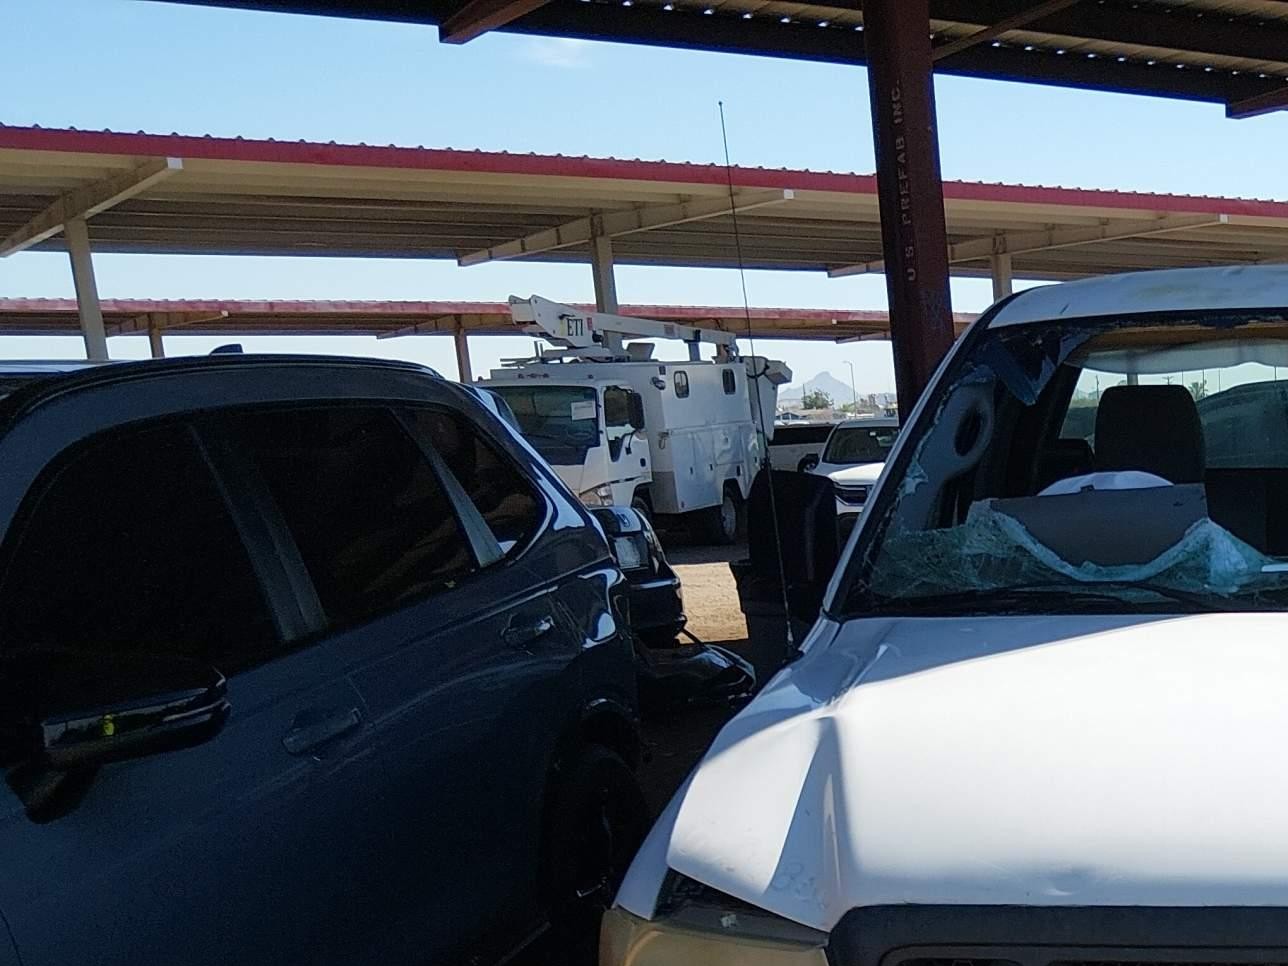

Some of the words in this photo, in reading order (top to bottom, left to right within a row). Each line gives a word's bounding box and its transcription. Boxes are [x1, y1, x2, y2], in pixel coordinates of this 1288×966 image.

[891, 80, 903, 124] INC.
[895, 136, 912, 225] PREFAB
[566, 317, 584, 337] ETI
